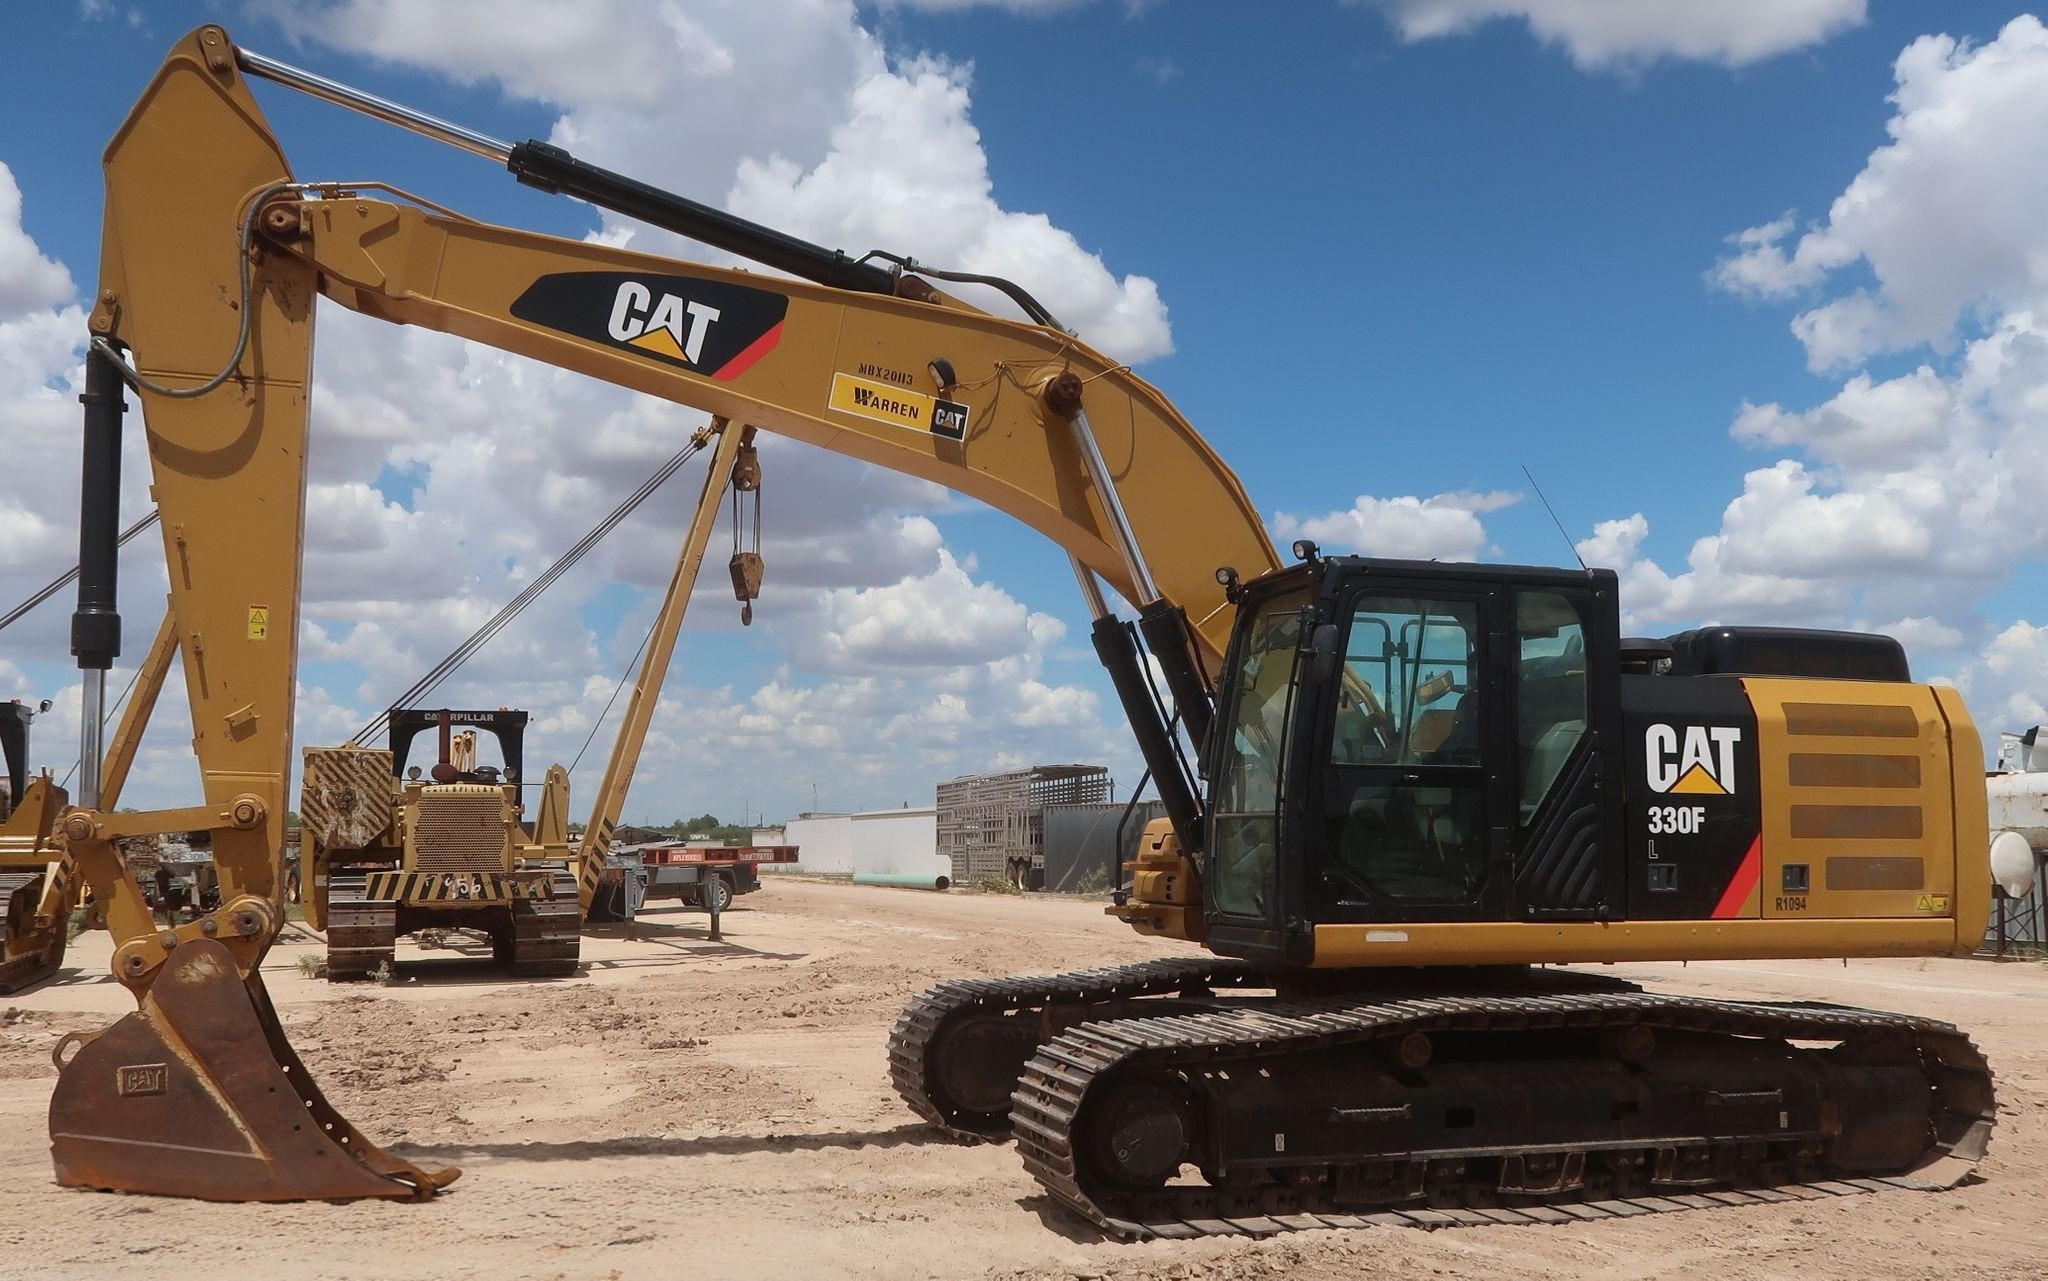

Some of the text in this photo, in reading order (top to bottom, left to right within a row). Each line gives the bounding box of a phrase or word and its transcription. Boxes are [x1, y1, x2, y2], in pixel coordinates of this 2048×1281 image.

[607, 281, 721, 365] CAT
[854, 387, 965, 430] WARREN CAT
[424, 713, 494, 722] CARPILLAR
[1645, 723, 1741, 794] CAT
[1648, 806, 1705, 834] 330F
[1648, 839, 1659, 859] L
[1775, 897, 1807, 912] R1094
[128, 1069, 162, 1092] CAT
